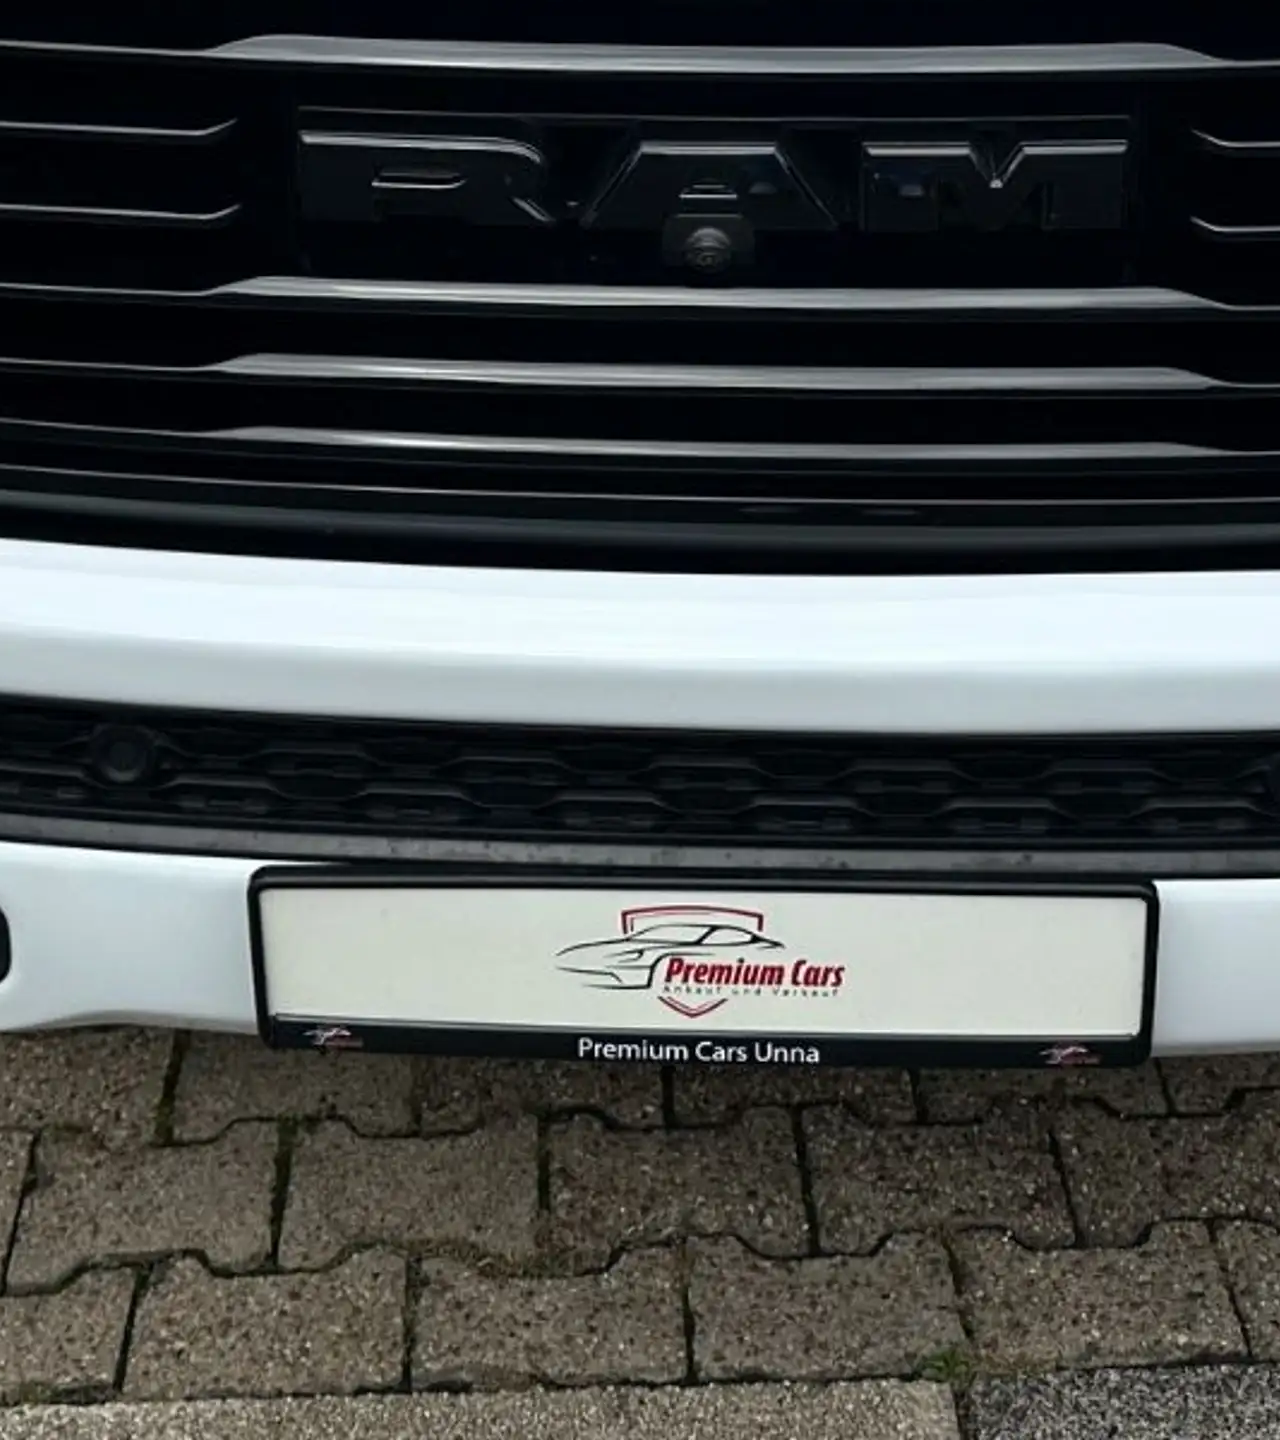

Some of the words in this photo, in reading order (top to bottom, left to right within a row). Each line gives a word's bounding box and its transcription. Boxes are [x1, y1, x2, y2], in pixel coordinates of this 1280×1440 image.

[298, 131, 1127, 232] RAM
[664, 957, 784, 986] Premium
[791, 959, 845, 988] Cars
[662, 985, 721, 995] Ankauf
[731, 987, 762, 997] und
[773, 988, 839, 998] Verkauf
[578, 1036, 689, 1060] Premium
[695, 1041, 748, 1062] Cars
[754, 1041, 820, 1063] Unna
